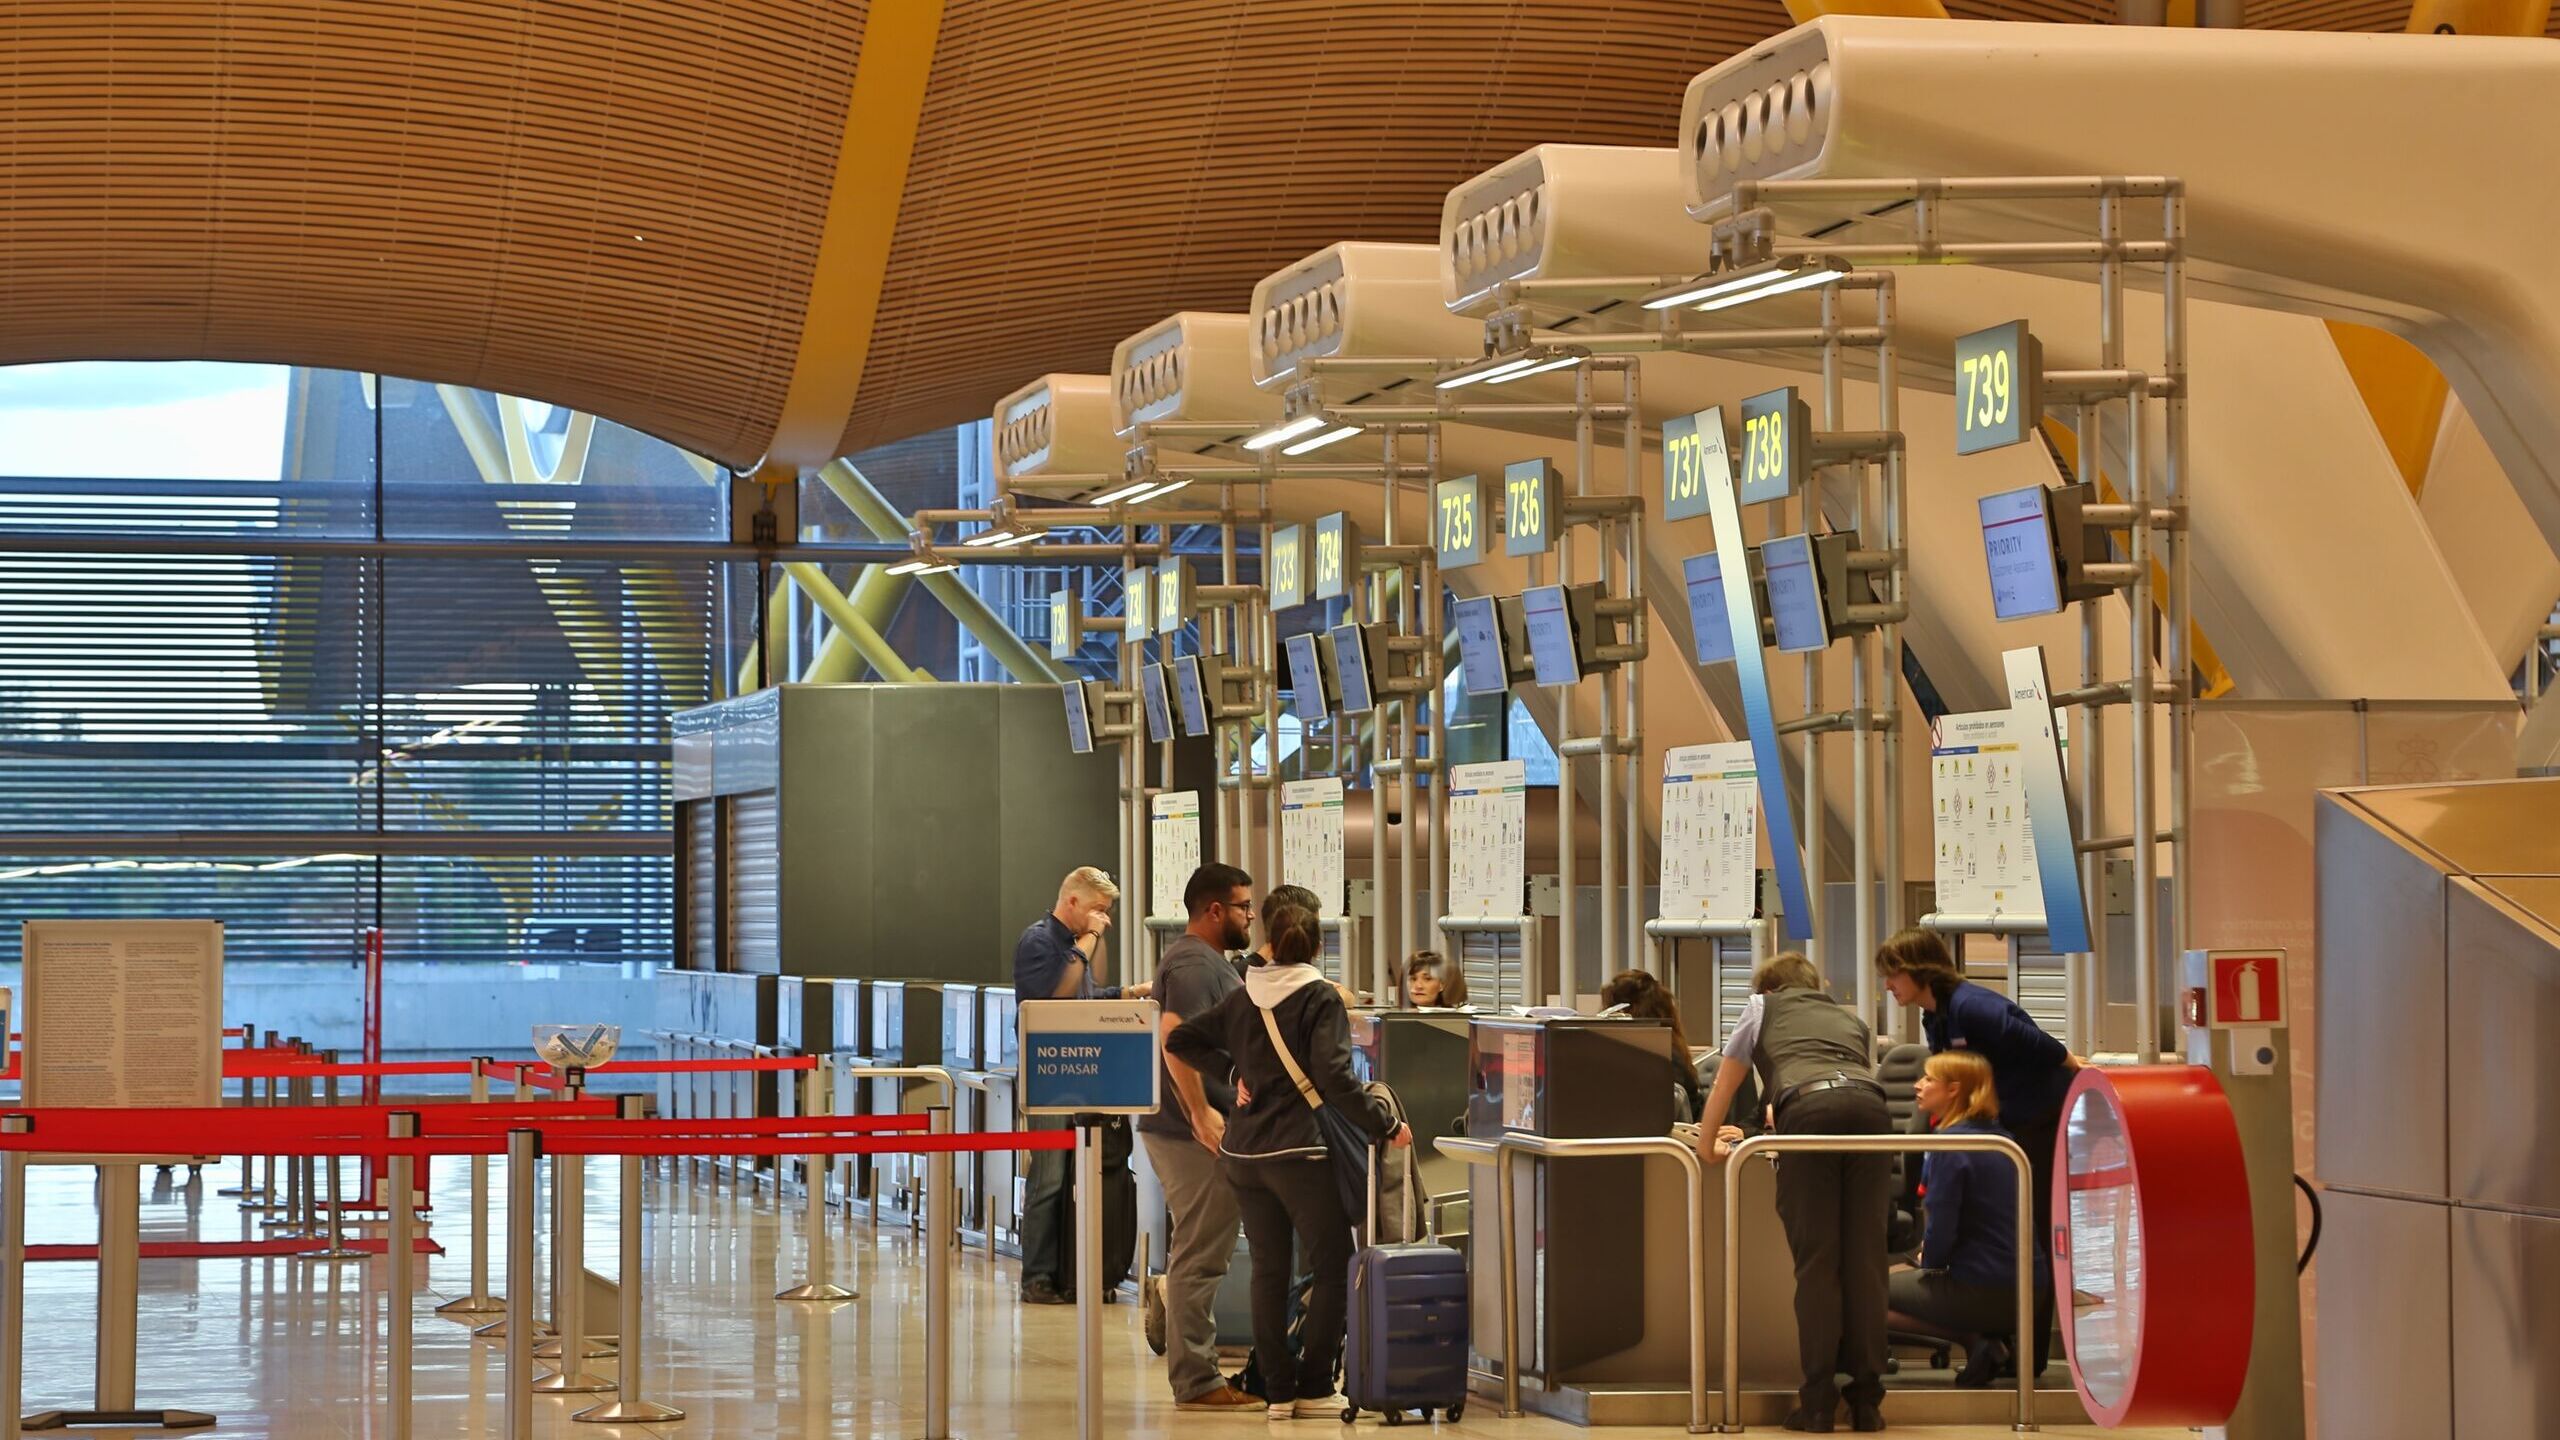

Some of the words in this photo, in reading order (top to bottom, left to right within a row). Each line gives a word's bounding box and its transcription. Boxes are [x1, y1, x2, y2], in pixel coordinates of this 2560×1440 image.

[1963, 350, 2009, 431] 739
[1669, 433, 1701, 502] 737
[1746, 411, 1782, 484] 738
[1442, 493, 1472, 552] 735
[1510, 478, 1539, 538] 736
[1274, 543, 1296, 596] 733
[1319, 529, 1339, 583] 734
[1987, 535, 2023, 558] PRIORITY
[1128, 582, 1143, 629] 731
[1161, 569, 1177, 619] 732
[1052, 603, 1067, 646] 730
[2014, 688, 2034, 700] American
[1099, 1015, 1134, 1023] American
[1037, 1046, 1058, 1058] NO
[1060, 1046, 1102, 1058] ENTRY
[1037, 1063, 1058, 1075] NO
[1060, 1063, 1099, 1075] PASAR
